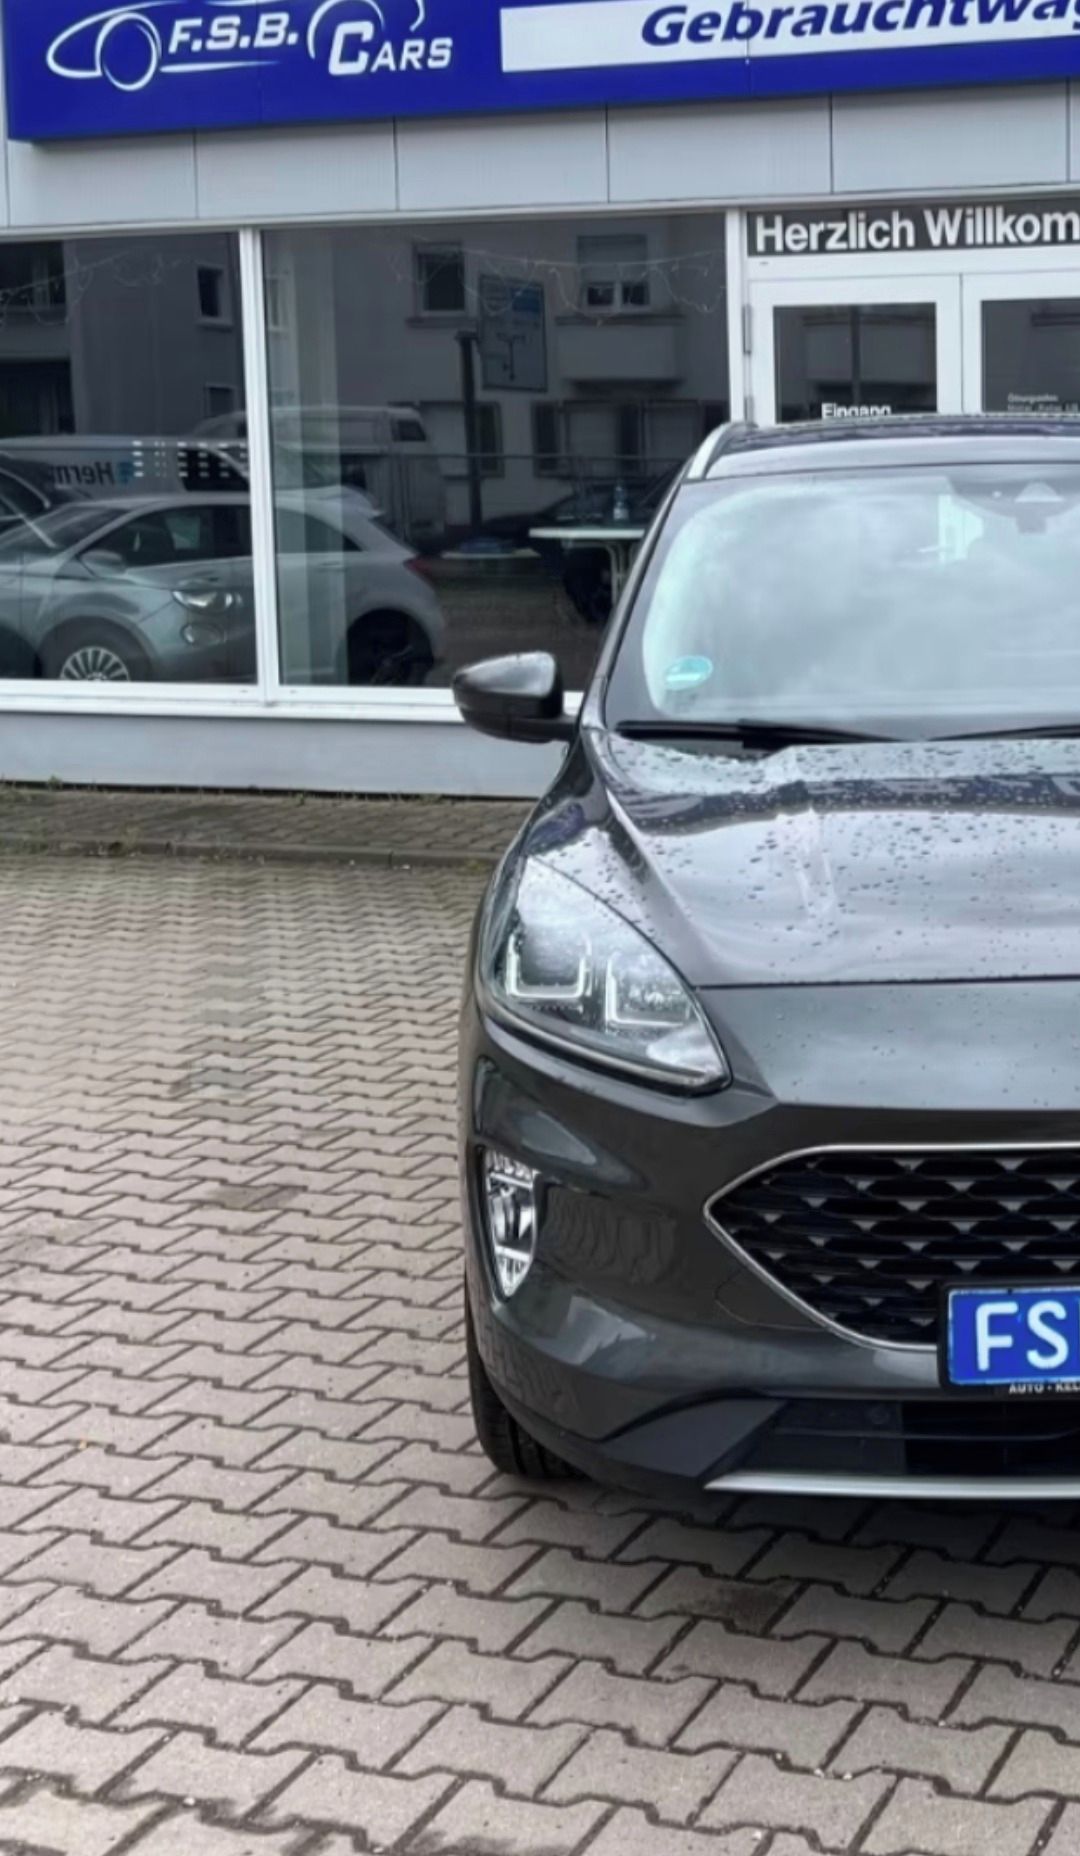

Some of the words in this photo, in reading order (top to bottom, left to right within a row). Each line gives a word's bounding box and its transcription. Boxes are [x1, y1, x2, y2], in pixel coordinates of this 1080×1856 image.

[168, 12, 298, 53] F.S.B.
[755, 209, 915, 253] Herzlich
[1008, 1381, 1045, 1394] AUTO
